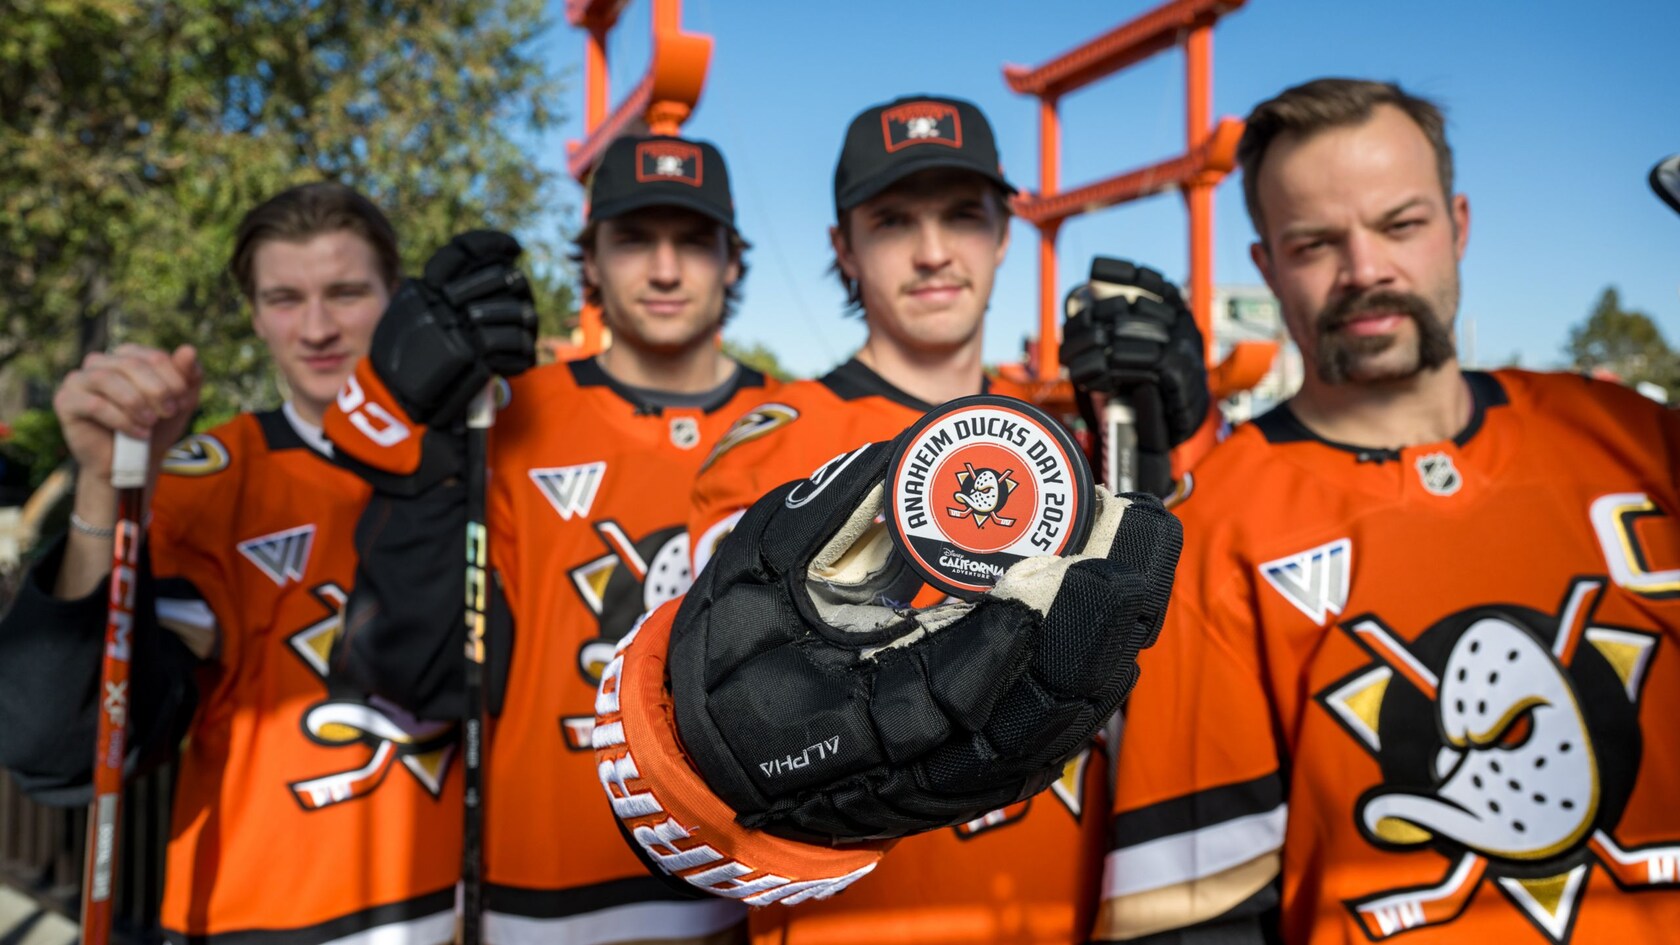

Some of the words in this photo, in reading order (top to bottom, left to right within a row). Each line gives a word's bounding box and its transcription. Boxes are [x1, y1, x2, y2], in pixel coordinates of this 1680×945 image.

[953, 417, 1031, 447] DUCKS
[904, 428, 954, 529] ANAHEIM
[1026, 440, 1064, 484] DAY
[1030, 493, 1065, 552] 2025
[939, 555, 1004, 577] CALIFORNIA
[952, 568, 990, 579] ADVENTURE
[106, 519, 139, 662] CCM
[464, 521, 487, 664] CCM
[759, 735, 839, 777] ALPHA
